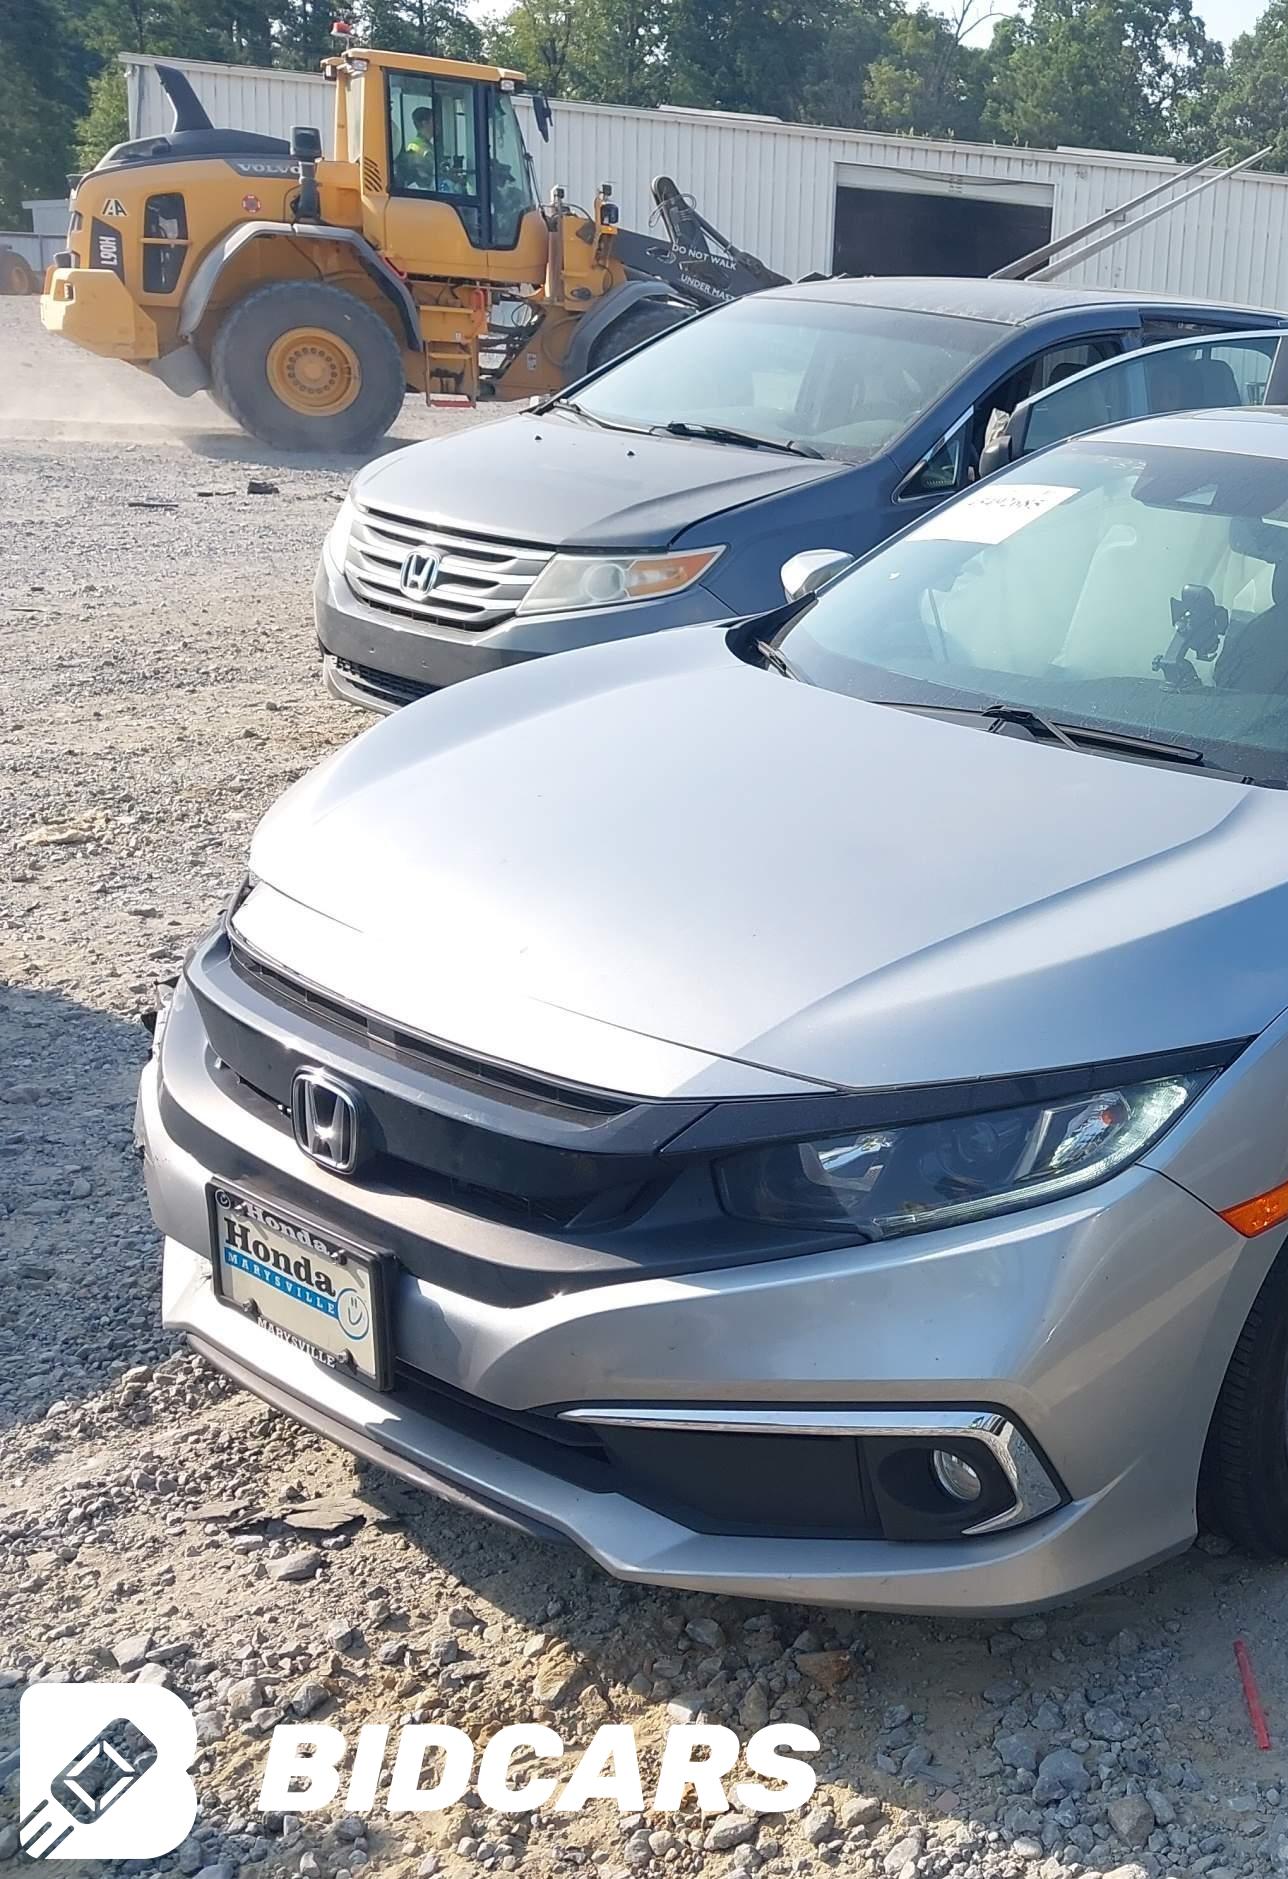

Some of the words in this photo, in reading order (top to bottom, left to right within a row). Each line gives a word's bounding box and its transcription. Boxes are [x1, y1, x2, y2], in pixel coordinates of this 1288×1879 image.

[237, 163, 300, 175] VOLVO
[99, 236, 119, 266] L90H
[672, 243, 687, 255] DO
[688, 249, 709, 261] NOT
[711, 255, 737, 271] WALK
[681, 273, 711, 295] UNDER
[246, 1202, 331, 1256] Honda
[224, 1217, 337, 1297] Honda
[228, 1251, 336, 1315] MARYSVILLE
[257, 1316, 337, 1369] MARYSVILLE
